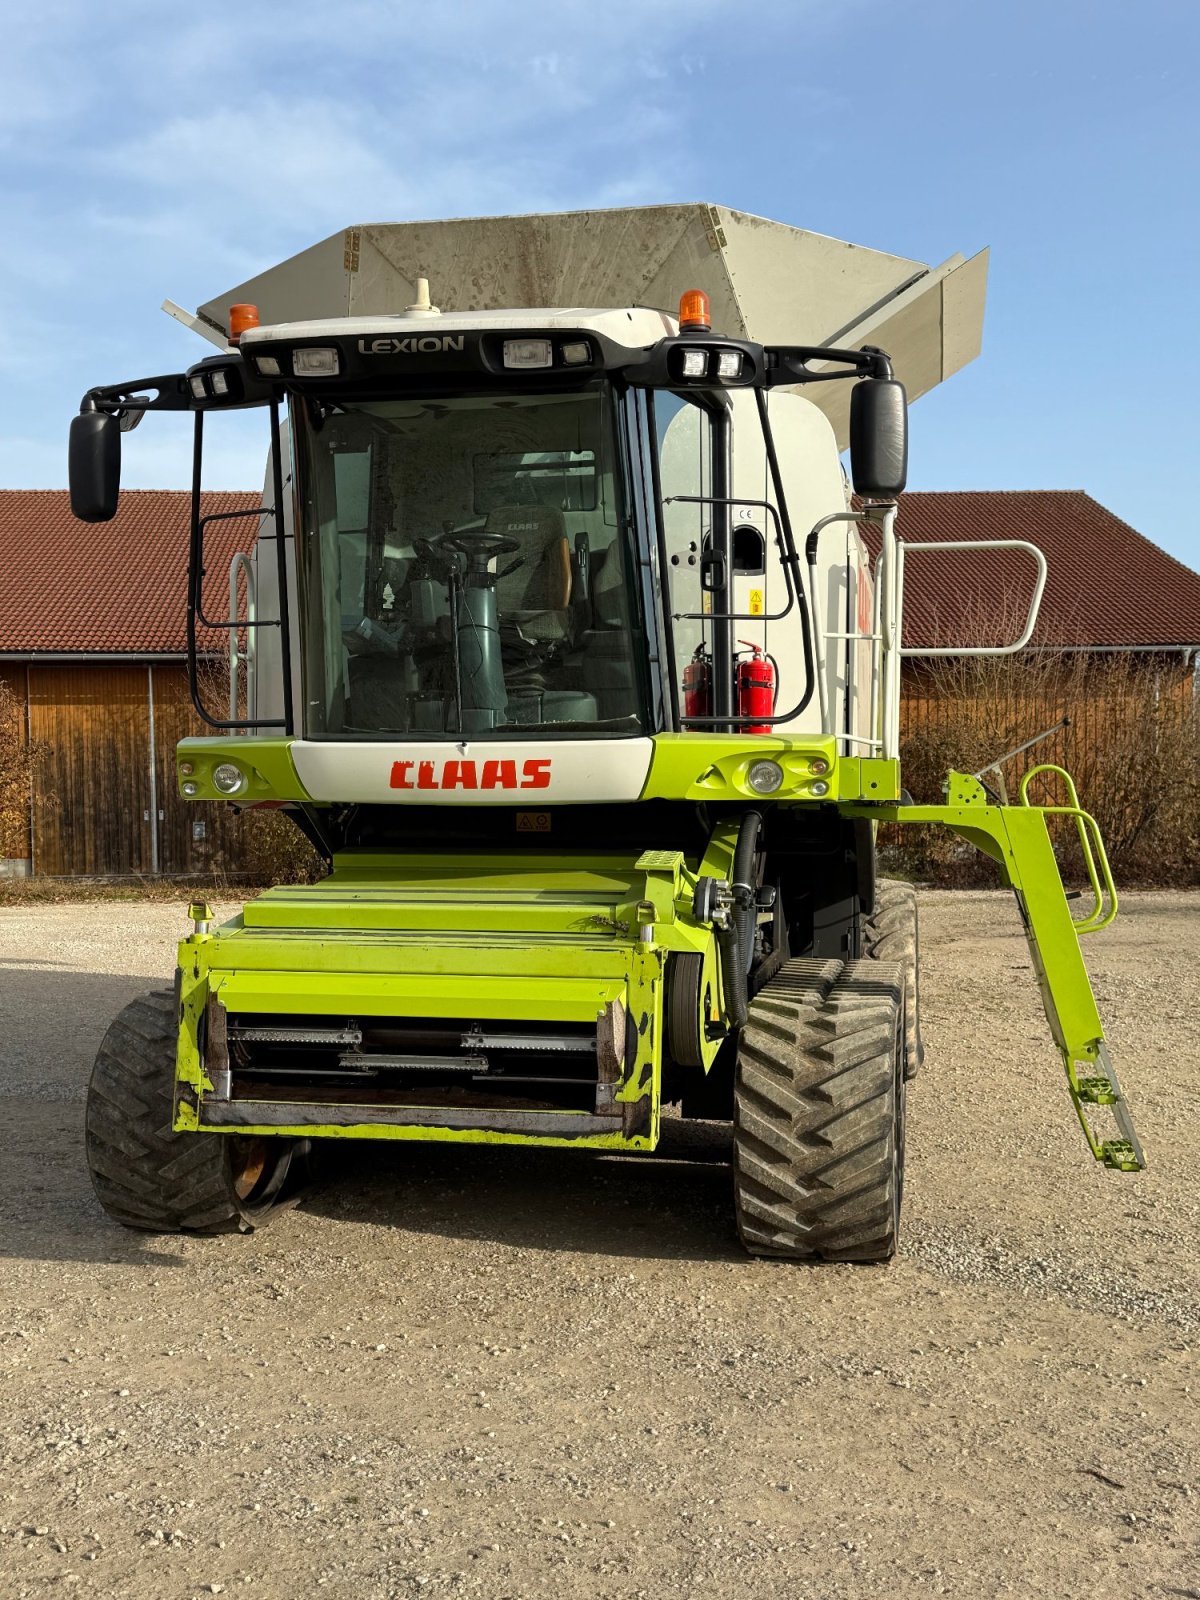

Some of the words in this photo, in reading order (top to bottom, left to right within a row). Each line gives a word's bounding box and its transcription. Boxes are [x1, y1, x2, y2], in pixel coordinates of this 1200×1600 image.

[358, 335, 465, 355] LEXION
[739, 509, 752, 519] CE
[507, 523, 539, 531] CLAAS
[389, 759, 552, 790] CLAAS
